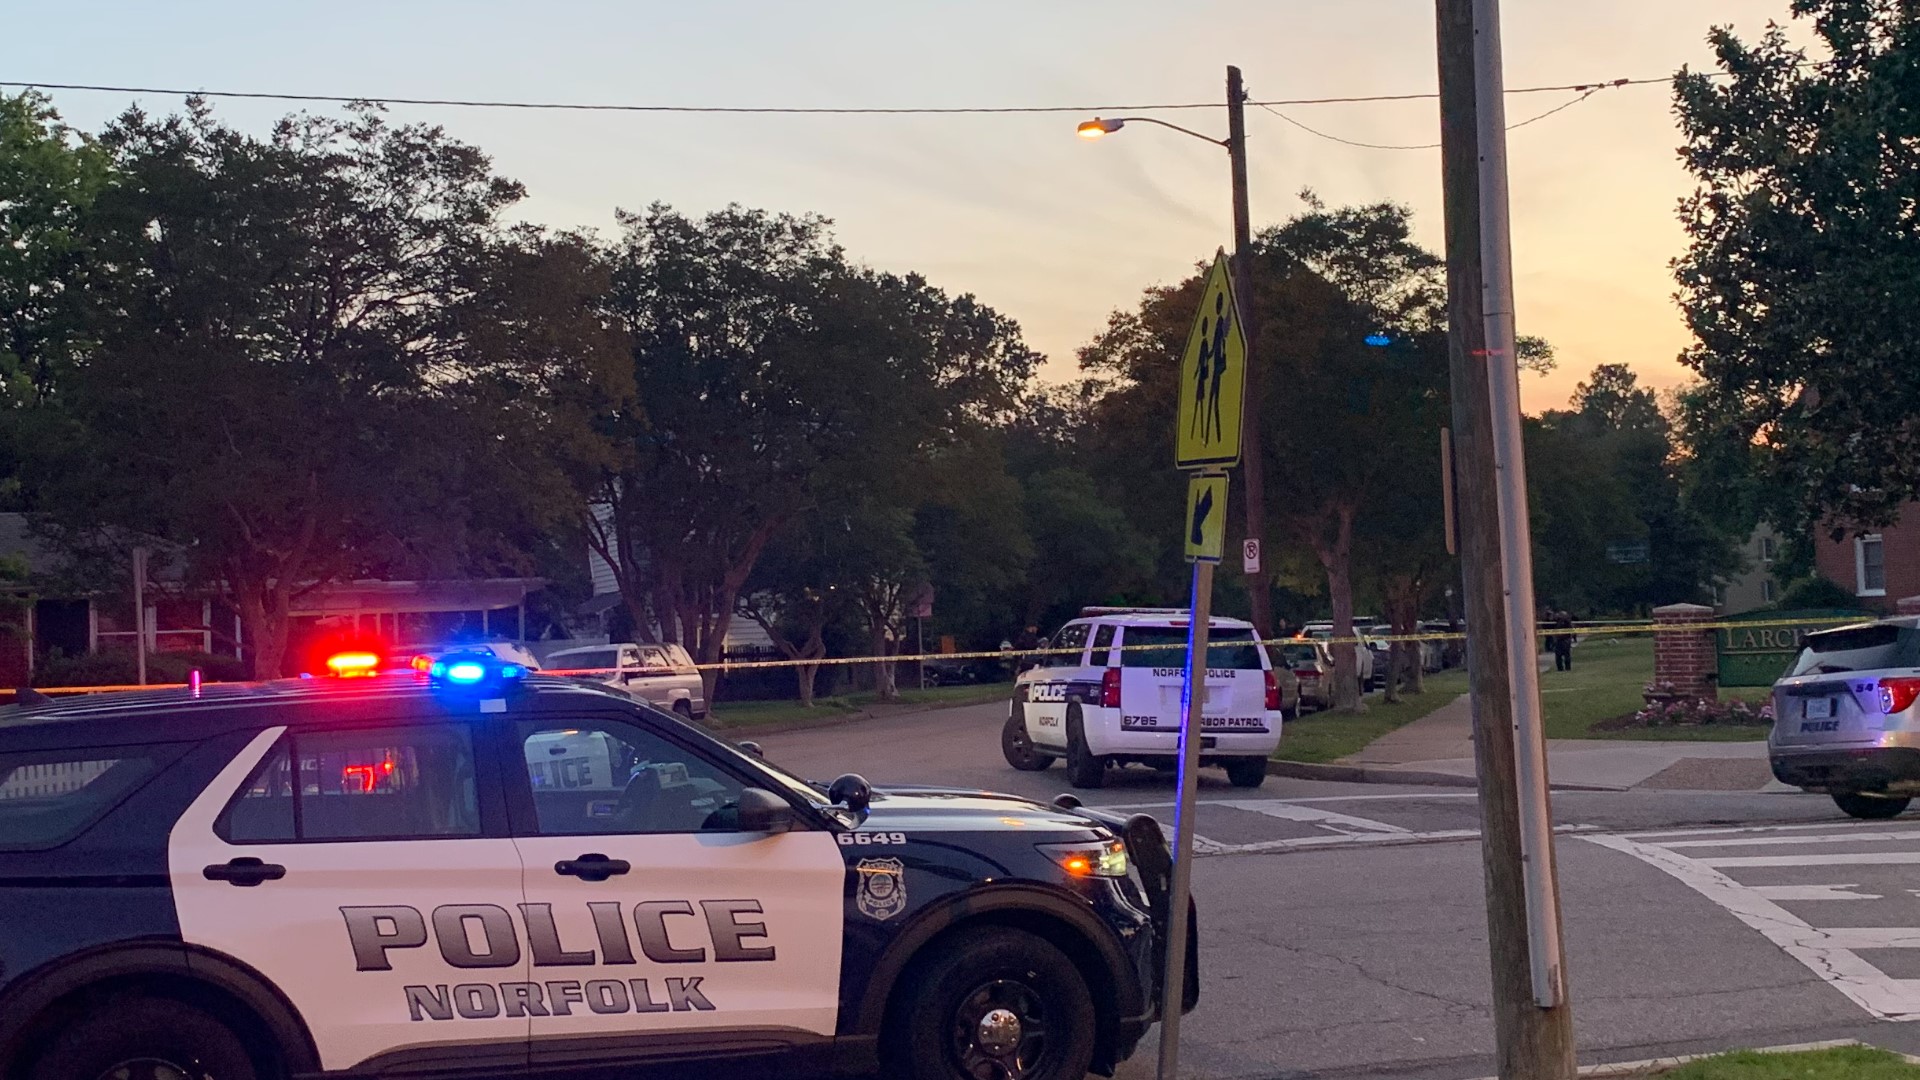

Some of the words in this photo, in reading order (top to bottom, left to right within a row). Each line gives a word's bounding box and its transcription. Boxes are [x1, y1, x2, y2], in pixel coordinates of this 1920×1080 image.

[1152, 668, 1186, 678] NORFO
[1034, 684, 1067, 701] POLICE
[1856, 683, 1874, 693] 54
[1123, 715, 1157, 726] 6785
[1201, 717, 1226, 727] RBOR
[1228, 717, 1263, 727] PATROL
[1800, 721, 1840, 732] POLICE
[529, 756, 593, 789] LICE
[837, 832, 907, 845] 6649
[339, 899, 776, 972] POLICE
[403, 976, 716, 1022] NORFOLK
